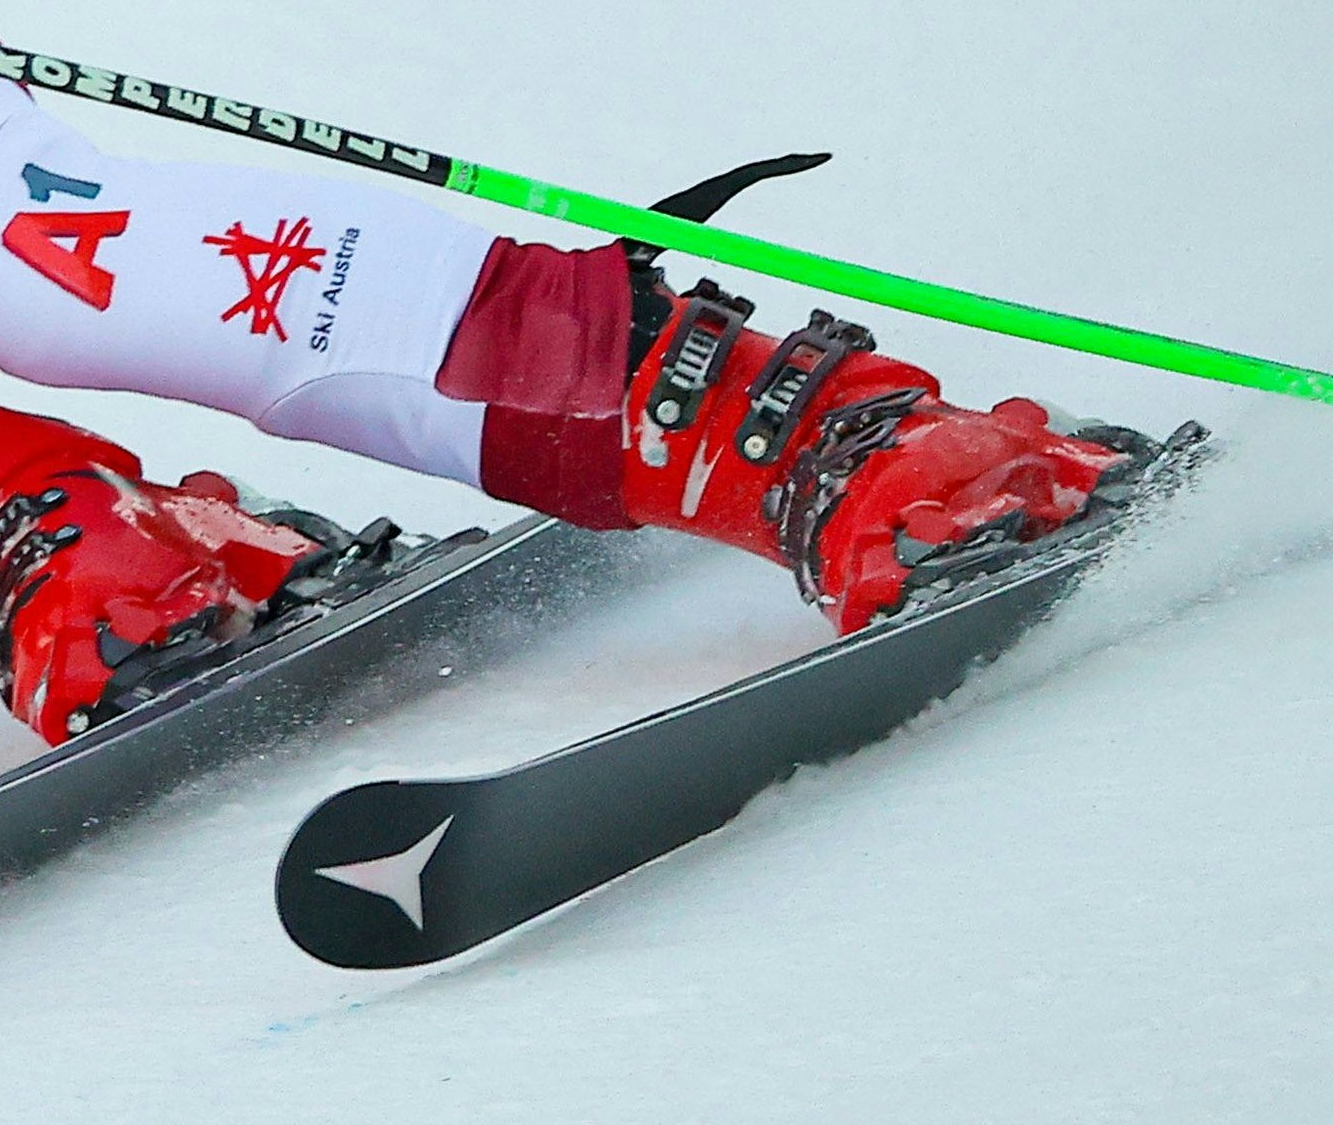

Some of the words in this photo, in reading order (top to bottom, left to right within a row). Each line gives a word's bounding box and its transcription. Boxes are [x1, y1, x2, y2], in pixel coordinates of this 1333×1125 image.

[1, 162, 131, 312] A1
[309, 311, 335, 354] Ski
[323, 226, 362, 305] Austria
